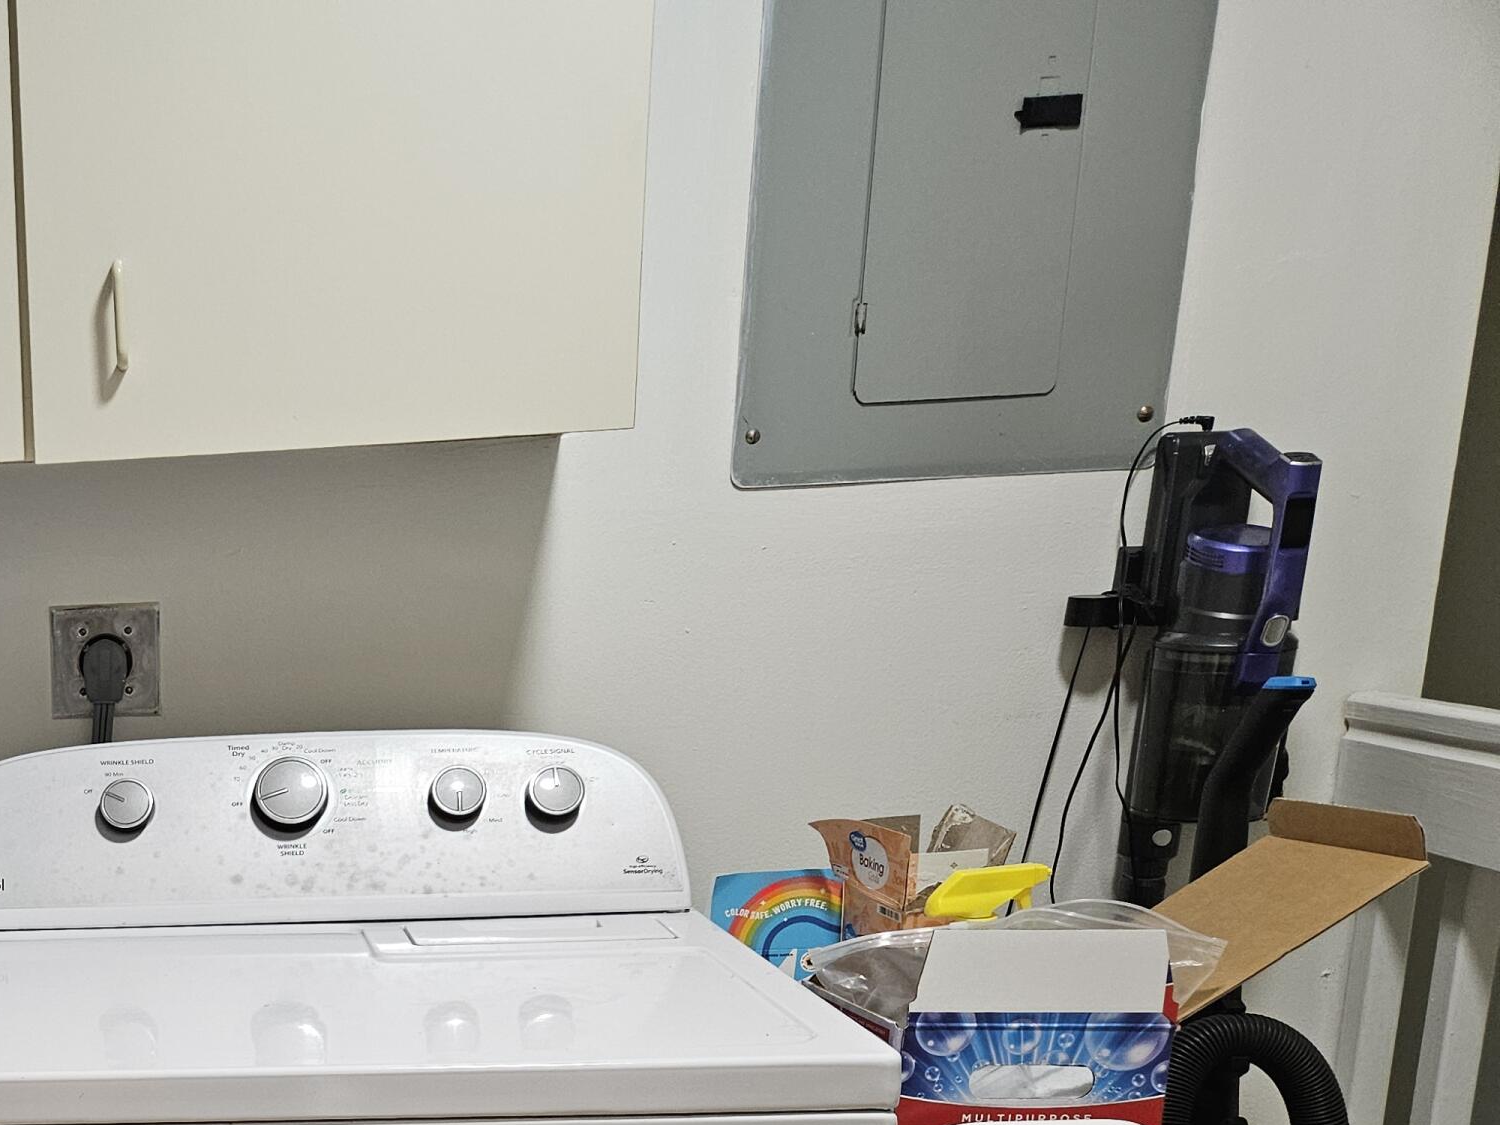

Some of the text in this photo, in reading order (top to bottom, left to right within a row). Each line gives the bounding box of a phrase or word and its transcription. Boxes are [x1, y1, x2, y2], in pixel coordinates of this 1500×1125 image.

[859, 852, 885, 878] Baking
[724, 898, 828, 920] COLOR SAFE. WORRY FREE.
